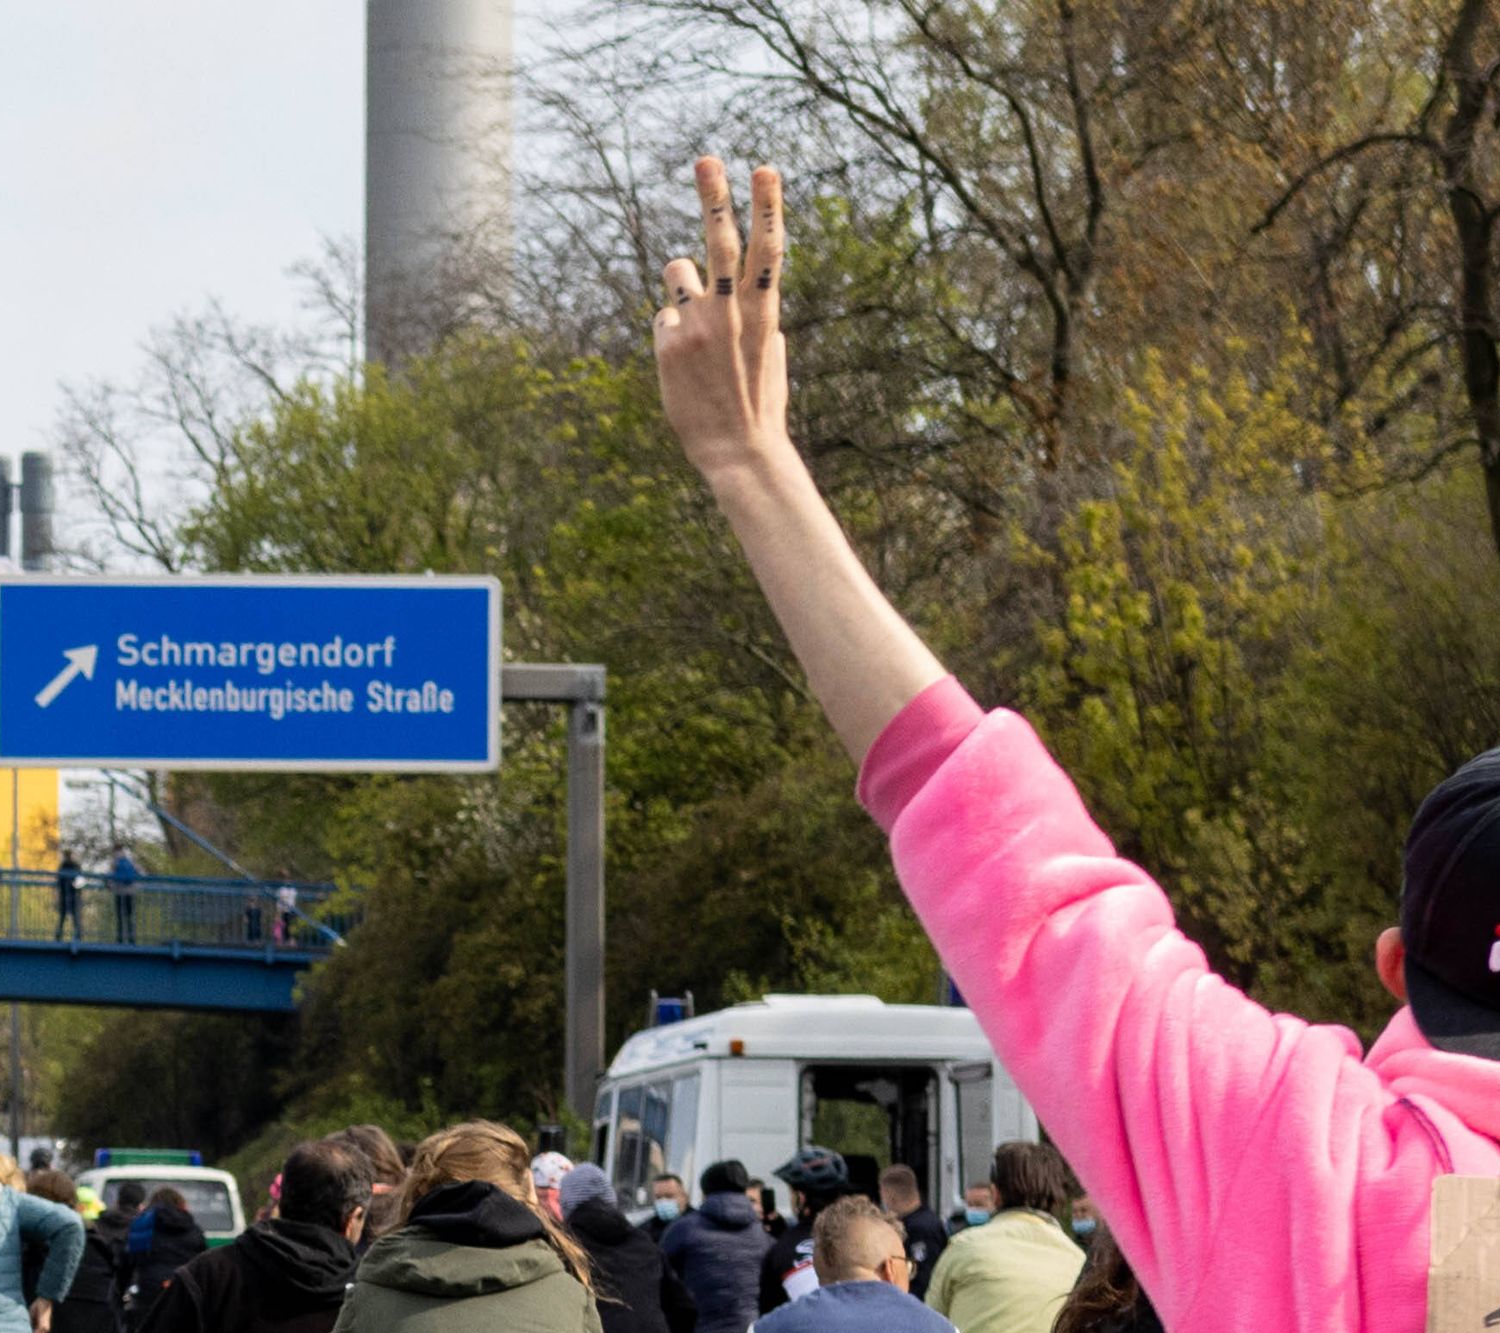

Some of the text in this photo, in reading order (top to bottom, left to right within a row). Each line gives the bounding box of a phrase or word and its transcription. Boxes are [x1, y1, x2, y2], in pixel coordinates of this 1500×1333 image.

[116, 633, 396, 675] Schmargendorf
[114, 679, 455, 721] Mecklenburgische Straße
